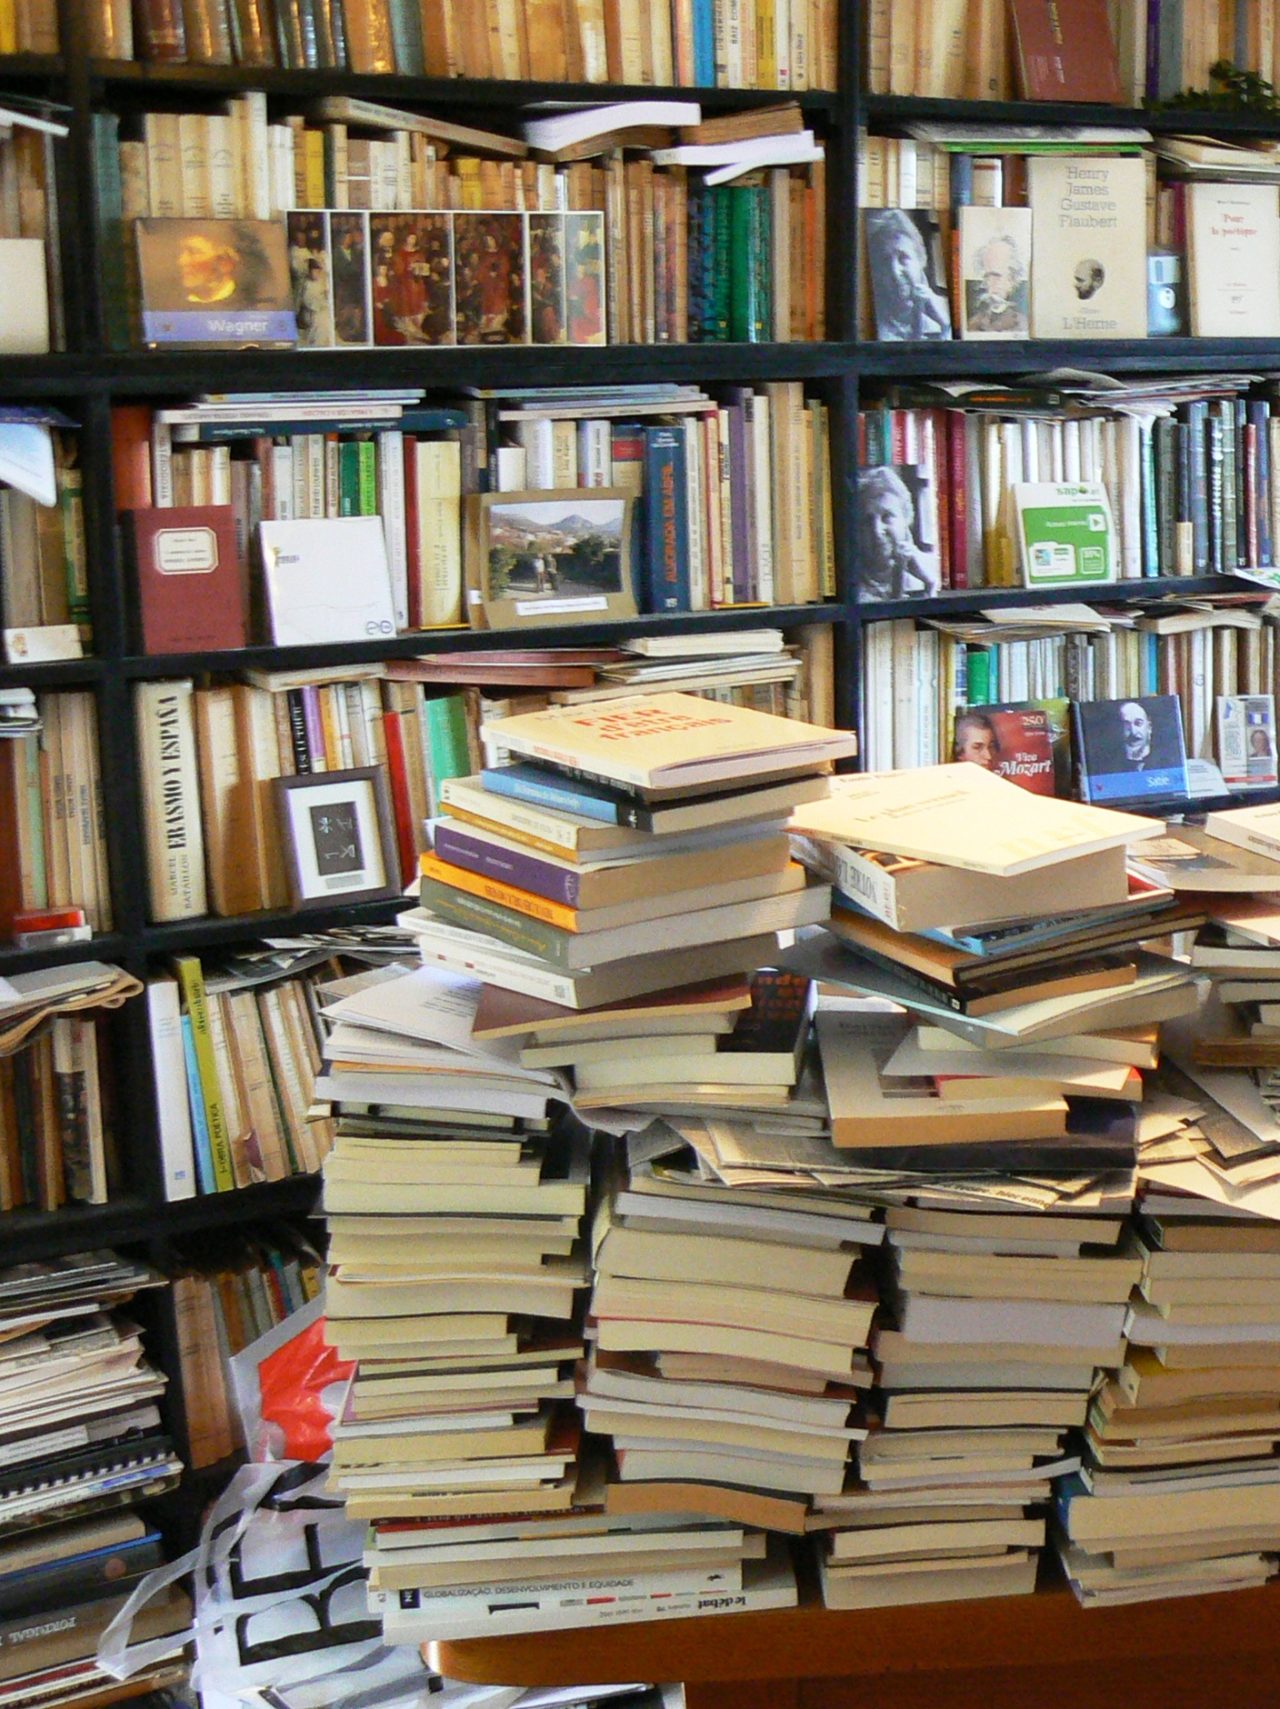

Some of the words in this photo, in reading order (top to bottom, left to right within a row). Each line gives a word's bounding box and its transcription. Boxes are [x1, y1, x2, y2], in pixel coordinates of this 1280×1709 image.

[1066, 165, 1110, 182] Henry
[1067, 182, 1110, 196] James
[1060, 198, 1117, 212] Gustave
[1059, 214, 1117, 228] Flaubert
[207, 319, 269, 335] Wagner
[574, 708, 670, 727] FIER
[155, 695, 181, 761] ESPAÑA
[162, 767, 181, 777] Y
[998, 759, 1051, 777] Mozart
[163, 779, 187, 849] ERASMO
[423, 1586, 494, 1601] GLOBALIZAÇÃO,
[495, 1582, 581, 1596] DESENVOLVIMENTO
[581, 1582, 587, 1590] E
[588, 1579, 635, 1590] EQUIDADE
[8, 1616, 77, 1643] PORTUGAL
